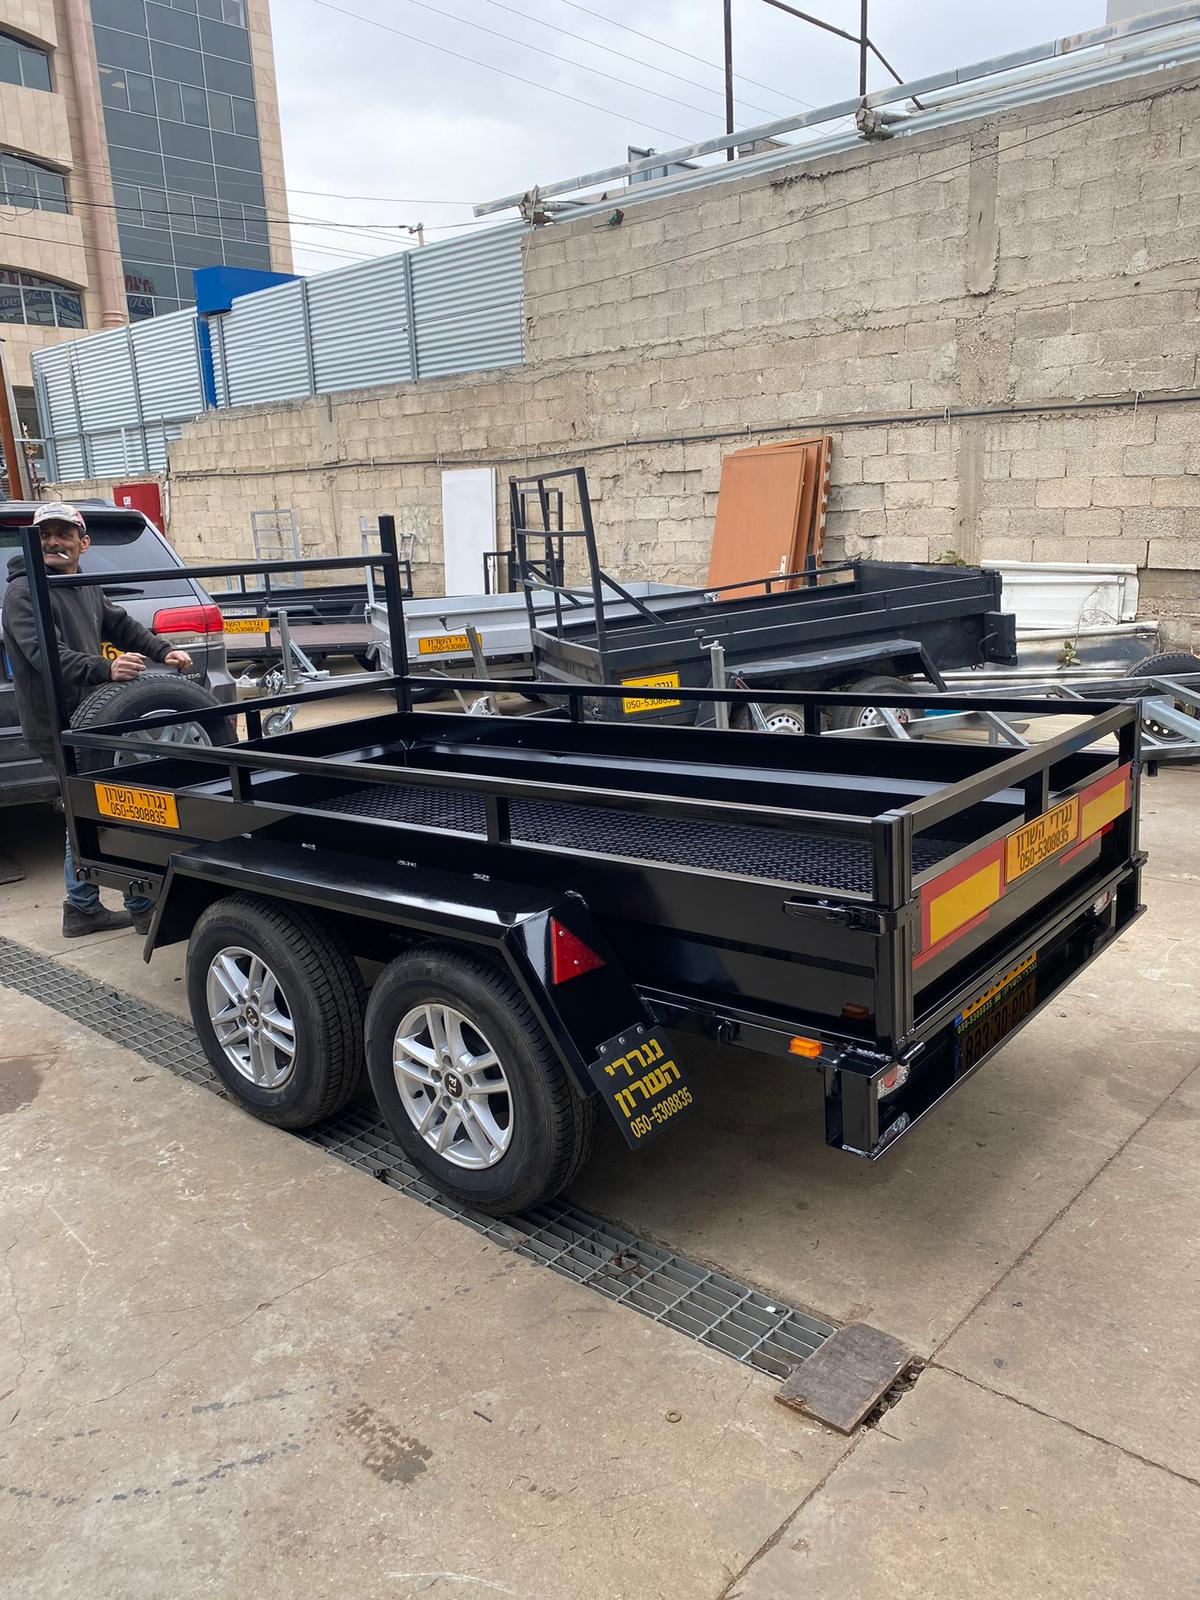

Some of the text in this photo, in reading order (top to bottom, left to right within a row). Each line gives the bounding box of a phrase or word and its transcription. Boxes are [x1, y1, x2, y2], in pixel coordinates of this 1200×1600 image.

[224, 620, 241, 628] השר
[427, 637, 451, 647] השרון
[431, 643, 470, 652] 050-530883
[104, 786, 167, 811] נגררי השרון
[110, 801, 166, 825] 050-5308835
[1017, 804, 1073, 858] נגררי השרון
[1020, 824, 1069, 871] 050-5308835
[604, 1038, 664, 1076] נגררי
[614, 1060, 681, 1118] השרון
[630, 1086, 693, 1138] 050-5308835
